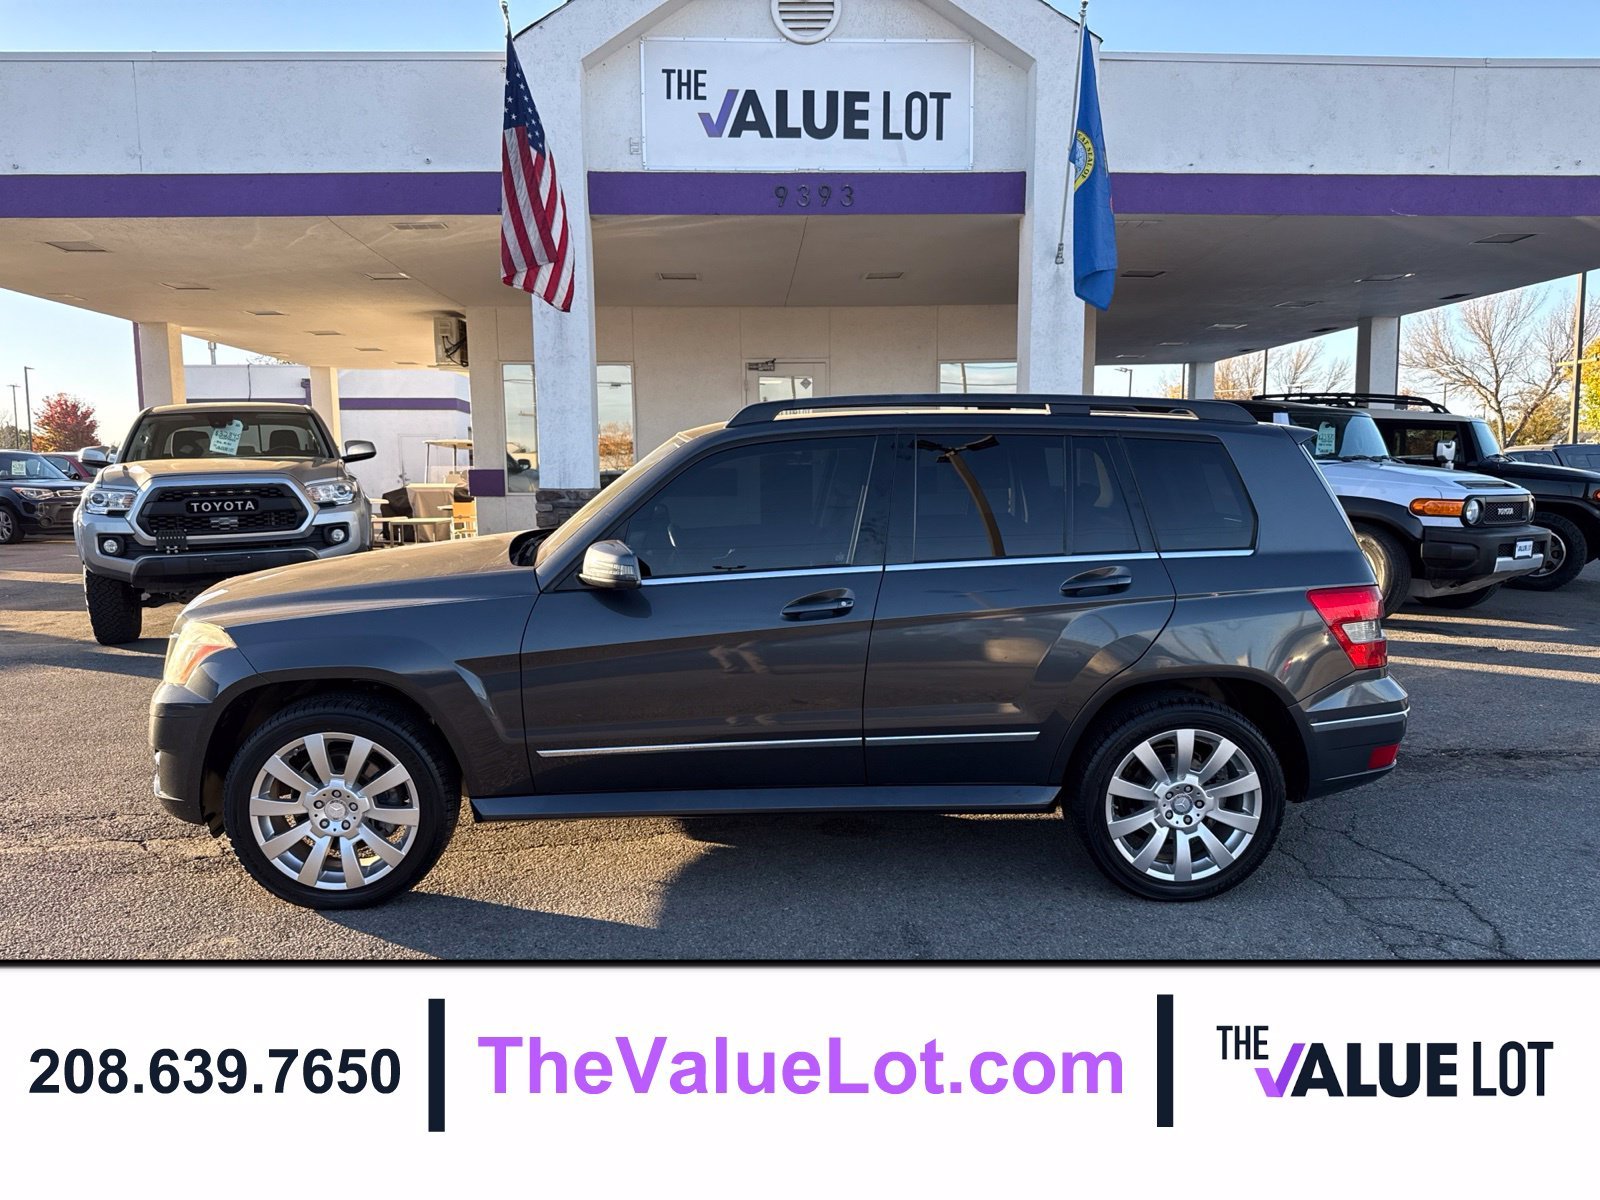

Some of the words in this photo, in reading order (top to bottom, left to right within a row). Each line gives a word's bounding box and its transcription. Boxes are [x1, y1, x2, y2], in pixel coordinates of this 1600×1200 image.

[661, 68, 707, 101] THE
[882, 90, 952, 141] LOT
[774, 184, 855, 208] 9393
[191, 501, 255, 513] TOYOTA
